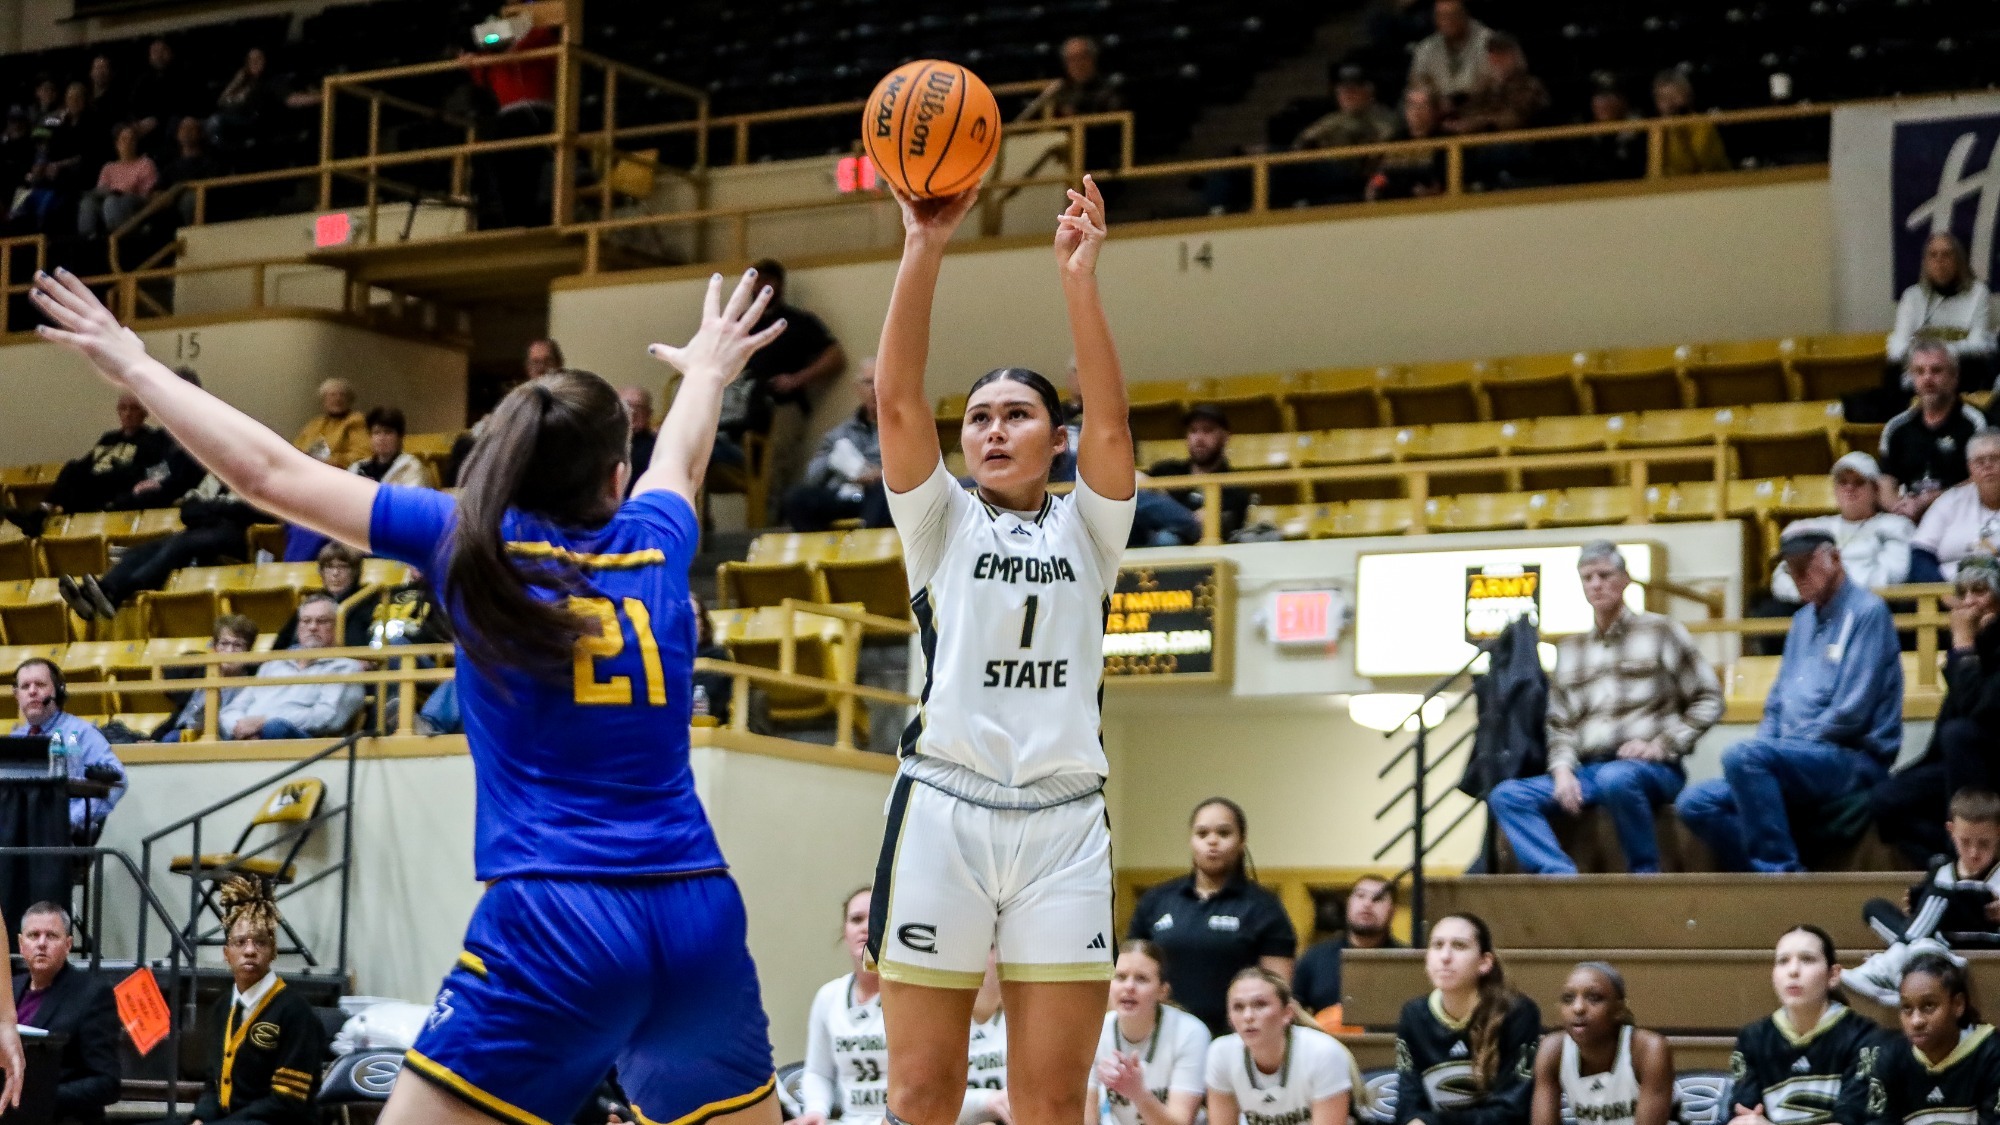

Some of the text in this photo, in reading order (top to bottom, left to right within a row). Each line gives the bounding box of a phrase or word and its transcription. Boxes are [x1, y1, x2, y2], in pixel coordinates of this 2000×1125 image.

[877, 75, 907, 138] NCAA
[909, 71, 955, 157] Wilson
[1179, 241, 1214, 273] 14
[177, 332, 201, 360] 15
[973, 552, 1077, 584] EMPORIA
[1124, 589, 1193, 612] NATION
[1469, 574, 1539, 598] ARMY
[1020, 594, 1039, 650] 1
[1127, 611, 1150, 633] AT
[1276, 592, 1332, 640] EXIT
[567, 595, 668, 706] 21
[983, 658, 1069, 689] STATE
[836, 1034, 887, 1052] EMPORI
[851, 1058, 883, 1082] 33
